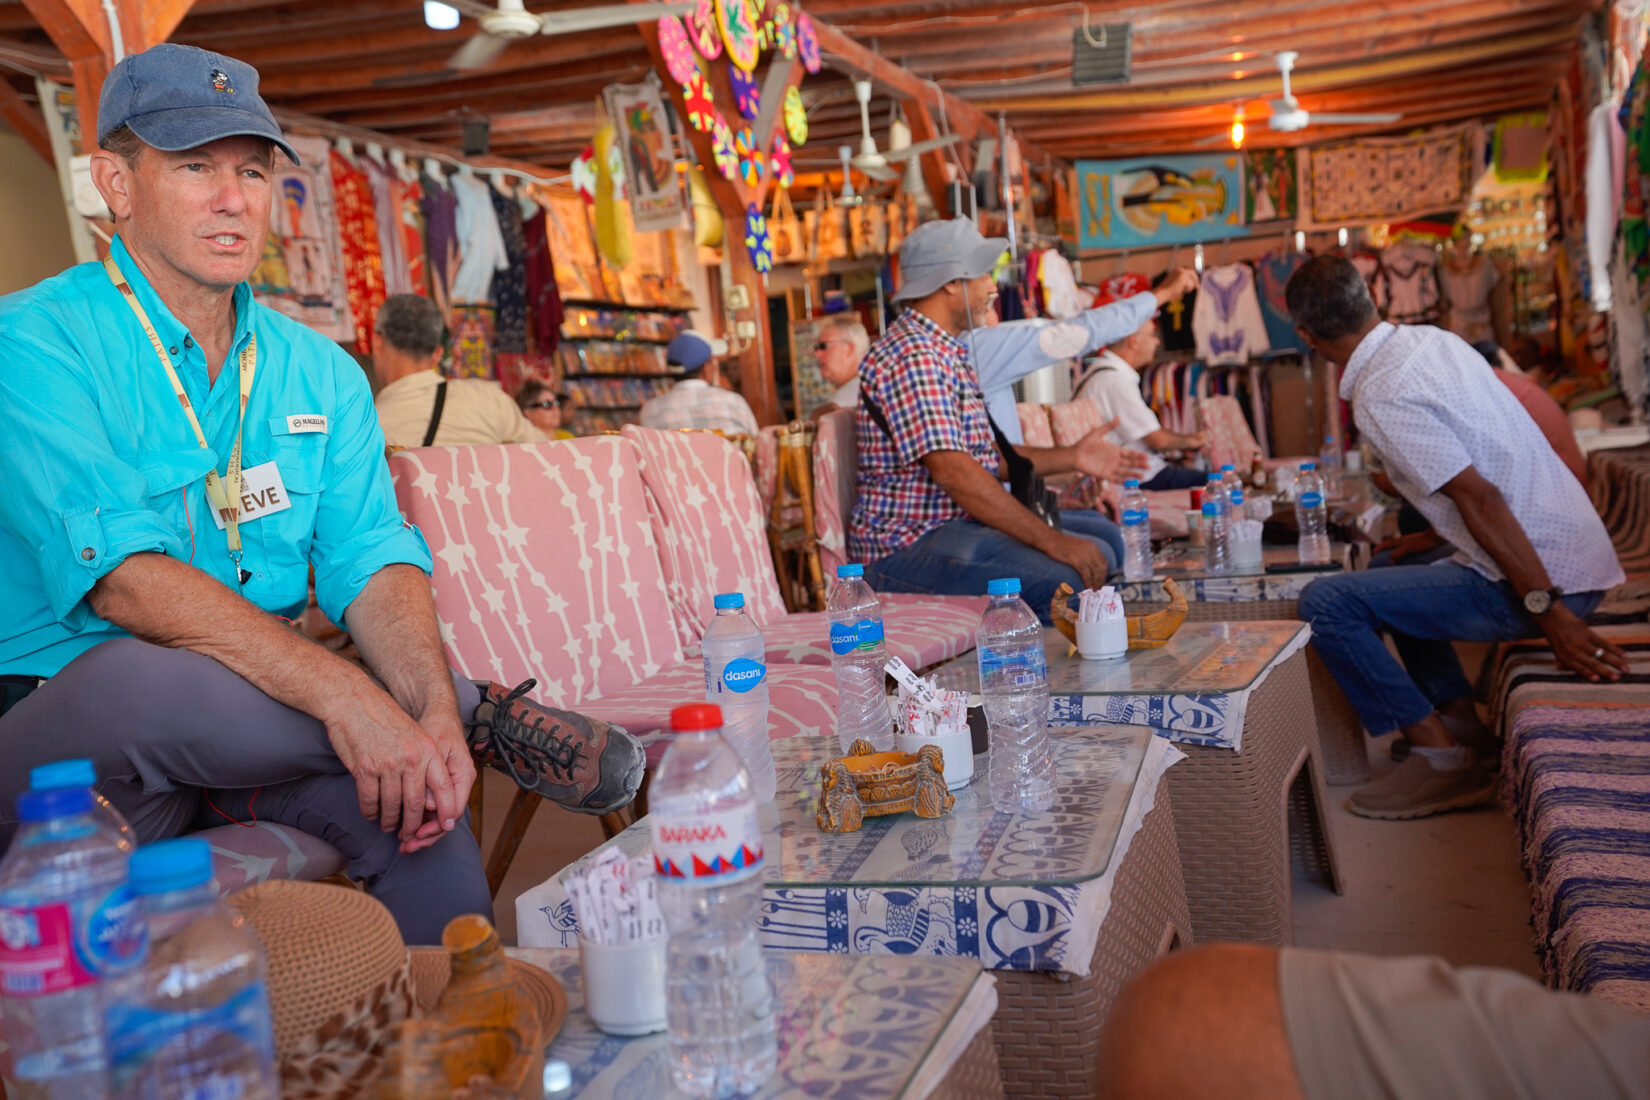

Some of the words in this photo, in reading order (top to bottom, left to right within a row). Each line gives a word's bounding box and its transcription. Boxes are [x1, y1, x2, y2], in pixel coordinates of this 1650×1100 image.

[145, 325, 168, 362] PATHS
[239, 486, 280, 514] EVE
[725, 666, 761, 681] dasani
[659, 823, 727, 844] BARAKA
